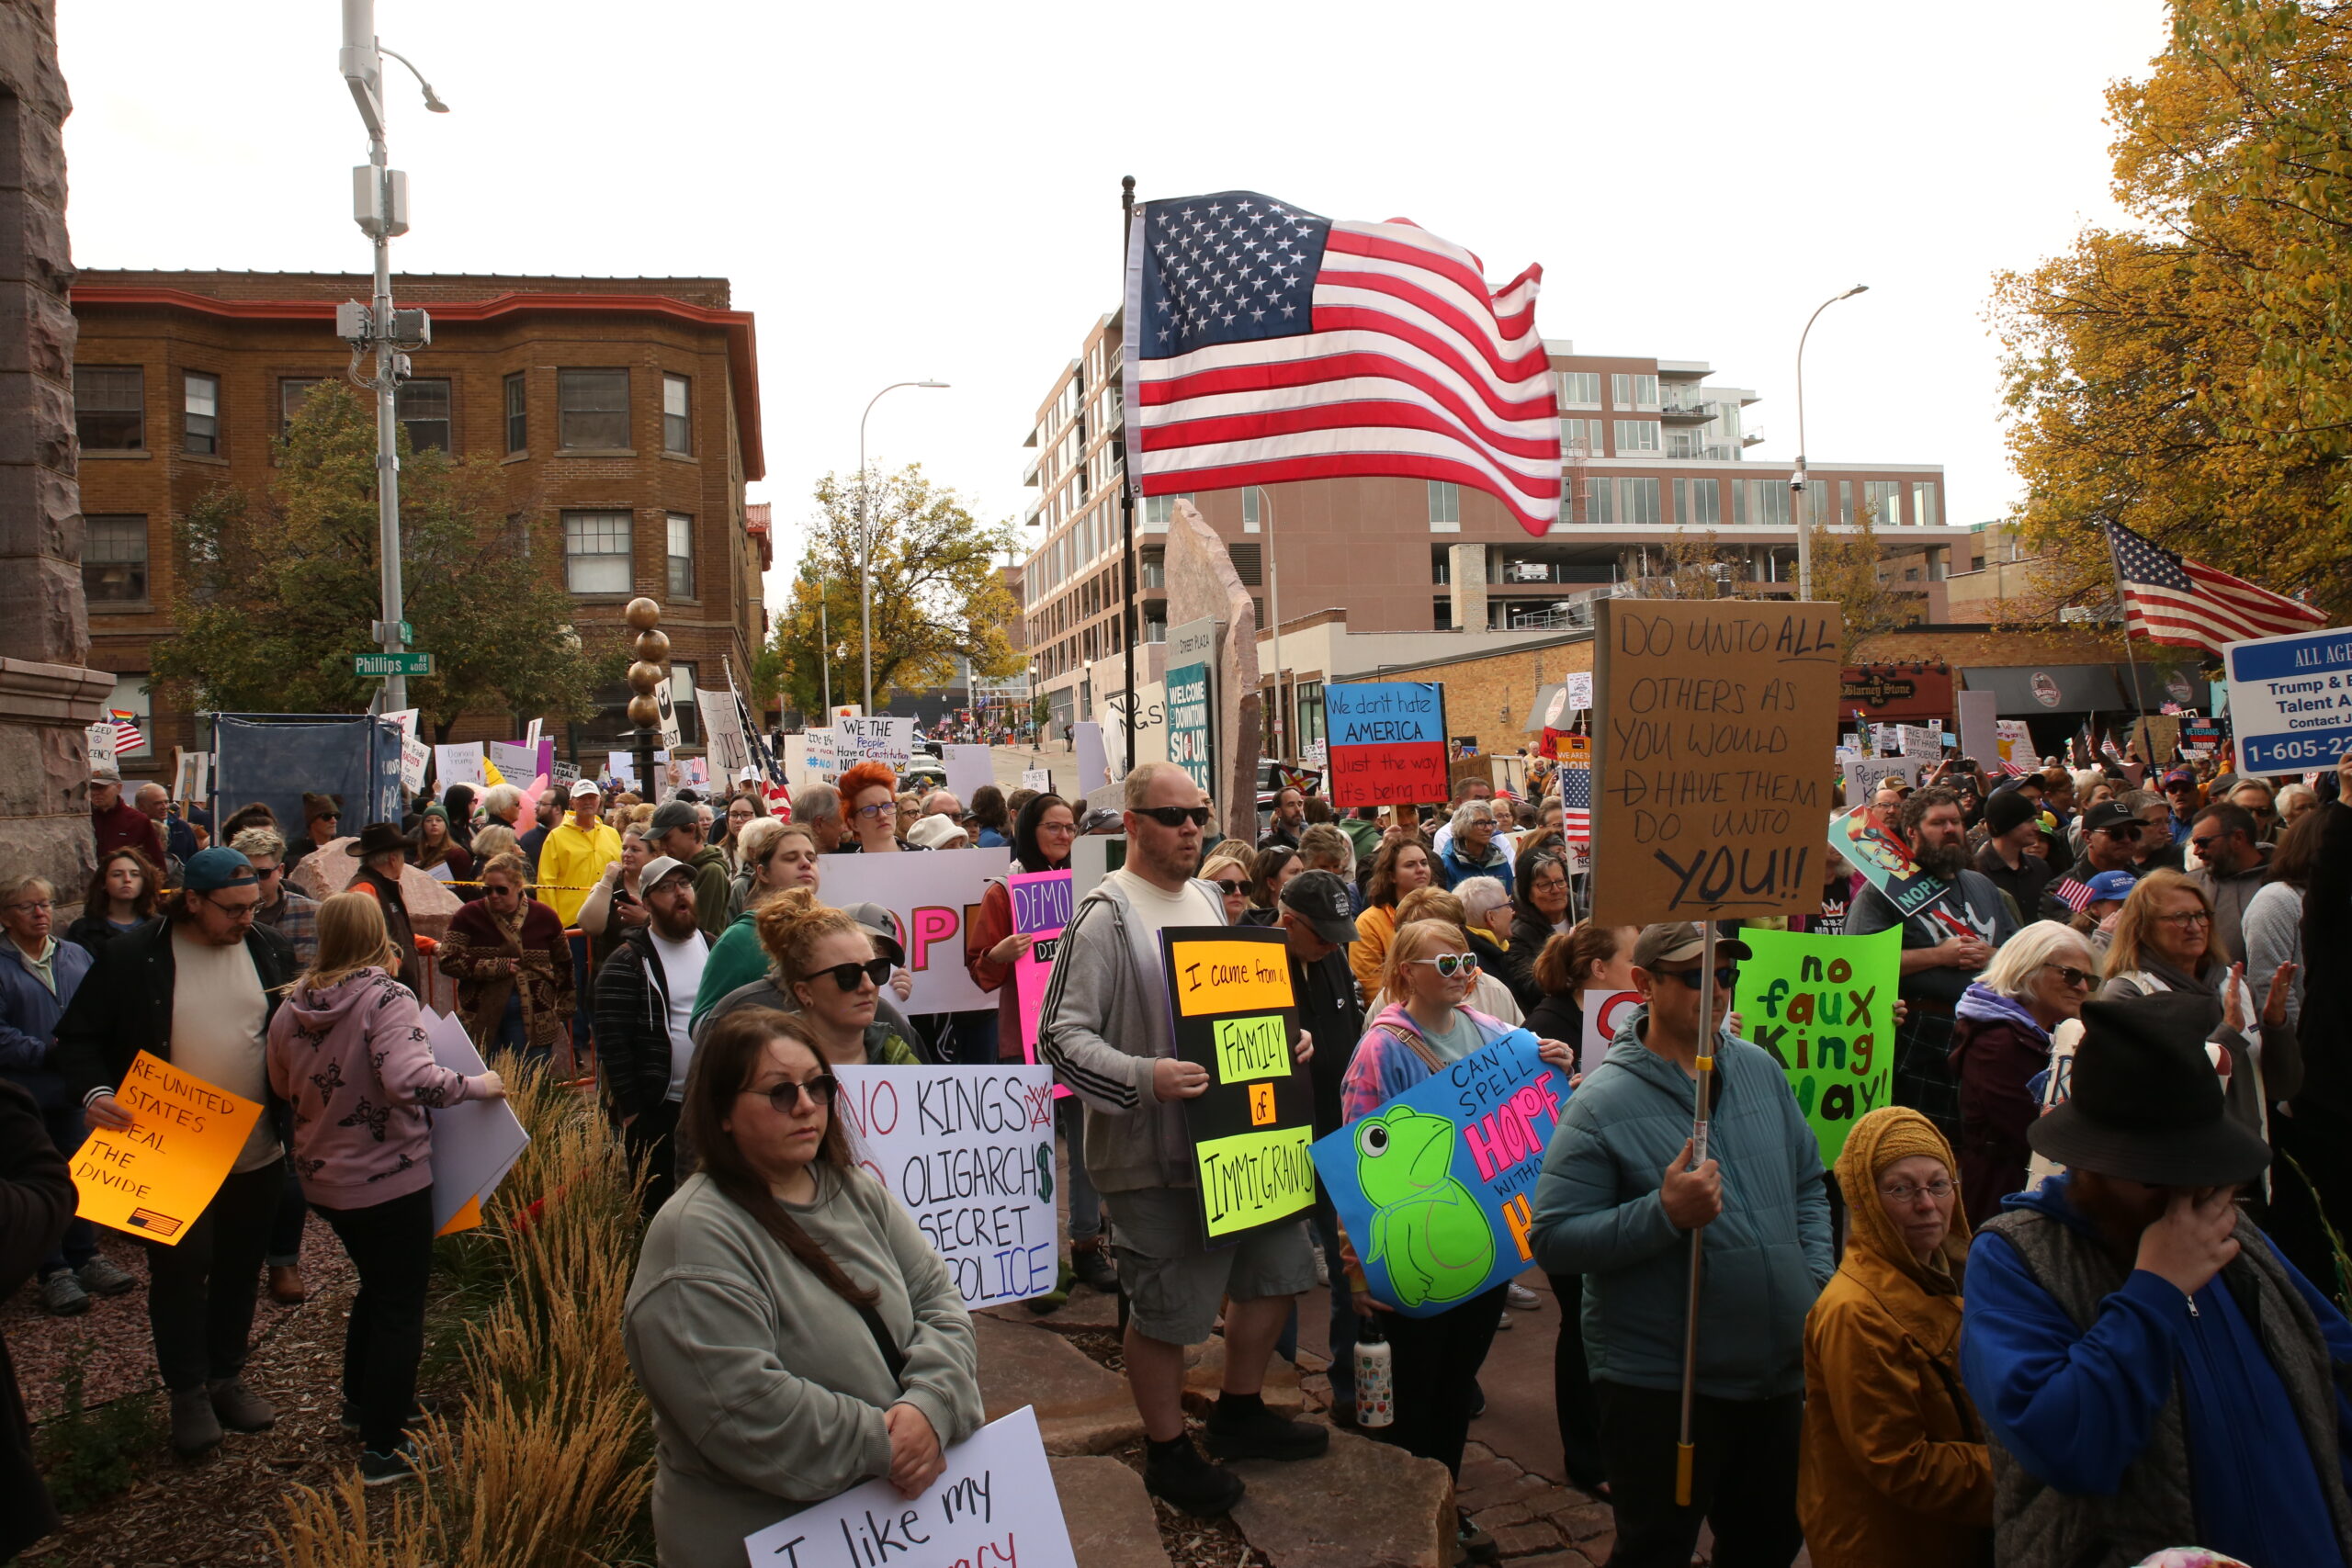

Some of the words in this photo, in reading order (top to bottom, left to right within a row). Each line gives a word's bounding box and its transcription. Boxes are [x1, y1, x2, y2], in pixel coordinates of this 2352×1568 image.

[1621, 613, 1674, 657] DO
[1688, 616, 1770, 656] UNTO
[1775, 615, 1837, 656] ALL
[356, 657, 402, 674] Phillips
[418, 654, 427, 662] AV
[409, 663, 427, 671] 400S
[2295, 647, 2323, 668] ALL
[1169, 681, 1204, 705] WELCOME
[1629, 678, 1747, 714] OTHERS
[1760, 678, 1798, 711] AS
[1844, 684, 1881, 697] Blarney
[1883, 682, 1911, 694] Stone
[2267, 679, 2324, 695] Trump
[2328, 676, 2341, 689] &
[1110, 693, 1140, 715] NO
[1175, 703, 1206, 730] DOWNTOWN
[1327, 693, 1350, 715] We
[1356, 692, 1393, 714] don't
[1398, 691, 1431, 713] hate
[2276, 695, 2334, 714] Talent
[843, 720, 865, 736] WE
[869, 721, 894, 737] THE
[1345, 720, 1424, 743] AMERICA
[1905, 728, 1920, 738] TAKE
[1923, 729, 1939, 741] YOUR
[2289, 716, 2341, 729] Contact
[857, 738, 885, 749] People
[1170, 729, 1207, 763] SIOUX
[1614, 717, 1673, 761] YOU
[1688, 723, 1788, 758] WOULD
[2192, 741, 2217, 750] TRUMP
[837, 747, 855, 757] Have
[866, 747, 909, 761] Constitution
[841, 760, 857, 772] NOT
[1335, 753, 1370, 773] Just
[1381, 753, 1406, 771] the
[1412, 756, 1438, 775] way
[1031, 772, 1045, 782] HERE
[1735, 770, 1817, 808] THEM
[1855, 765, 1905, 785] Rejecting
[1340, 784, 1365, 801] it's
[1373, 781, 1413, 804] being
[1634, 808, 1681, 843] DO
[1713, 809, 1791, 838] UNTO
[1654, 845, 1808, 911] YOU!!
[1898, 874, 1945, 909] NOPE
[1013, 880, 1070, 932] DEMO
[1185, 963, 1202, 992] I
[1211, 963, 1250, 987] came
[1255, 959, 1277, 985] from
[1279, 967, 1287, 986] a
[1800, 955, 1852, 984] no
[1757, 977, 1876, 1029] faux
[1222, 1021, 1284, 1077] FAMILY
[1451, 1036, 1517, 1089] CAN'T
[1753, 1024, 1874, 1077] King
[131, 1058, 234, 1115] RE-UNITED
[1459, 1060, 1534, 1118] SPELL
[125, 1086, 207, 1134] STATES
[837, 1079, 899, 1139] NO
[917, 1076, 1027, 1136] KINGS
[1255, 1092, 1268, 1121] of
[110, 1122, 167, 1155] EAL
[90, 1140, 135, 1169] THE
[75, 1162, 152, 1200] DIVIDE
[1204, 1139, 1314, 1224] IMMIGRANTS
[1494, 1154, 1545, 1197] WITHO
[919, 1205, 1031, 1252] SECRET
[774, 1536, 806, 1568] I
[840, 1509, 931, 1568] like
[942, 1471, 991, 1525] my
